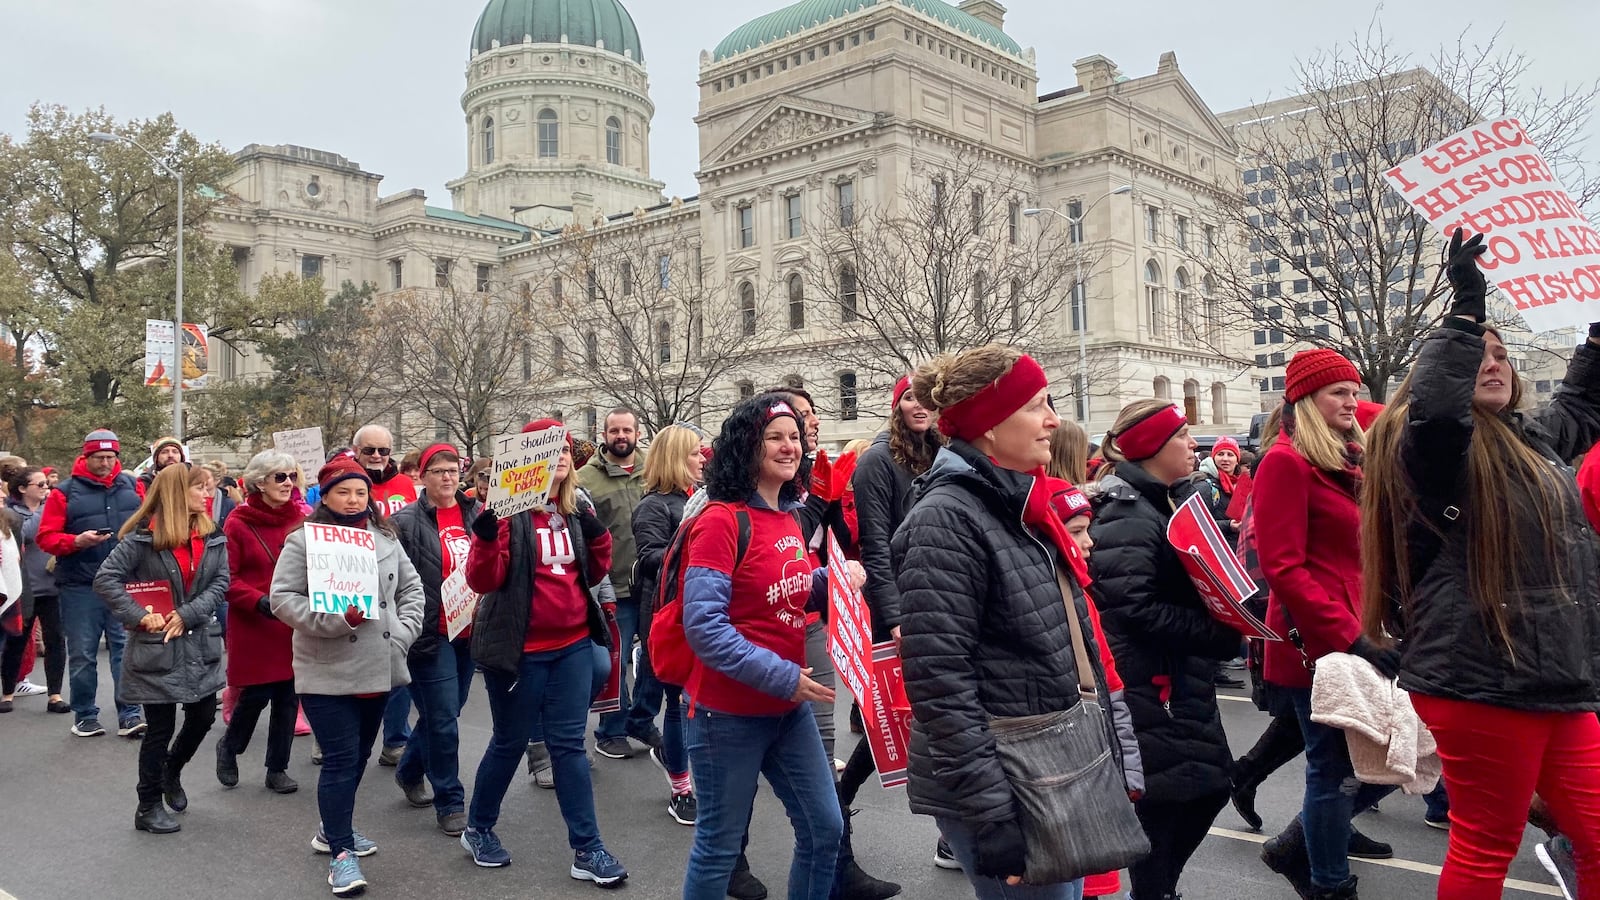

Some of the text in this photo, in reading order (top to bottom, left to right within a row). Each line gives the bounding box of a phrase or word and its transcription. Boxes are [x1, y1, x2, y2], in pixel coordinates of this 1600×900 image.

[1386, 166, 1419, 193] I
[498, 430, 565, 456] I shouldn't
[495, 447, 561, 473] have to marry
[490, 478, 497, 488] a
[505, 465, 544, 483] Sugar
[489, 490, 532, 510] teach in
[496, 492, 547, 518] NDIANA!
[307, 523, 375, 551] TEACHERS
[307, 553, 330, 570] JUST
[323, 572, 366, 593] have
